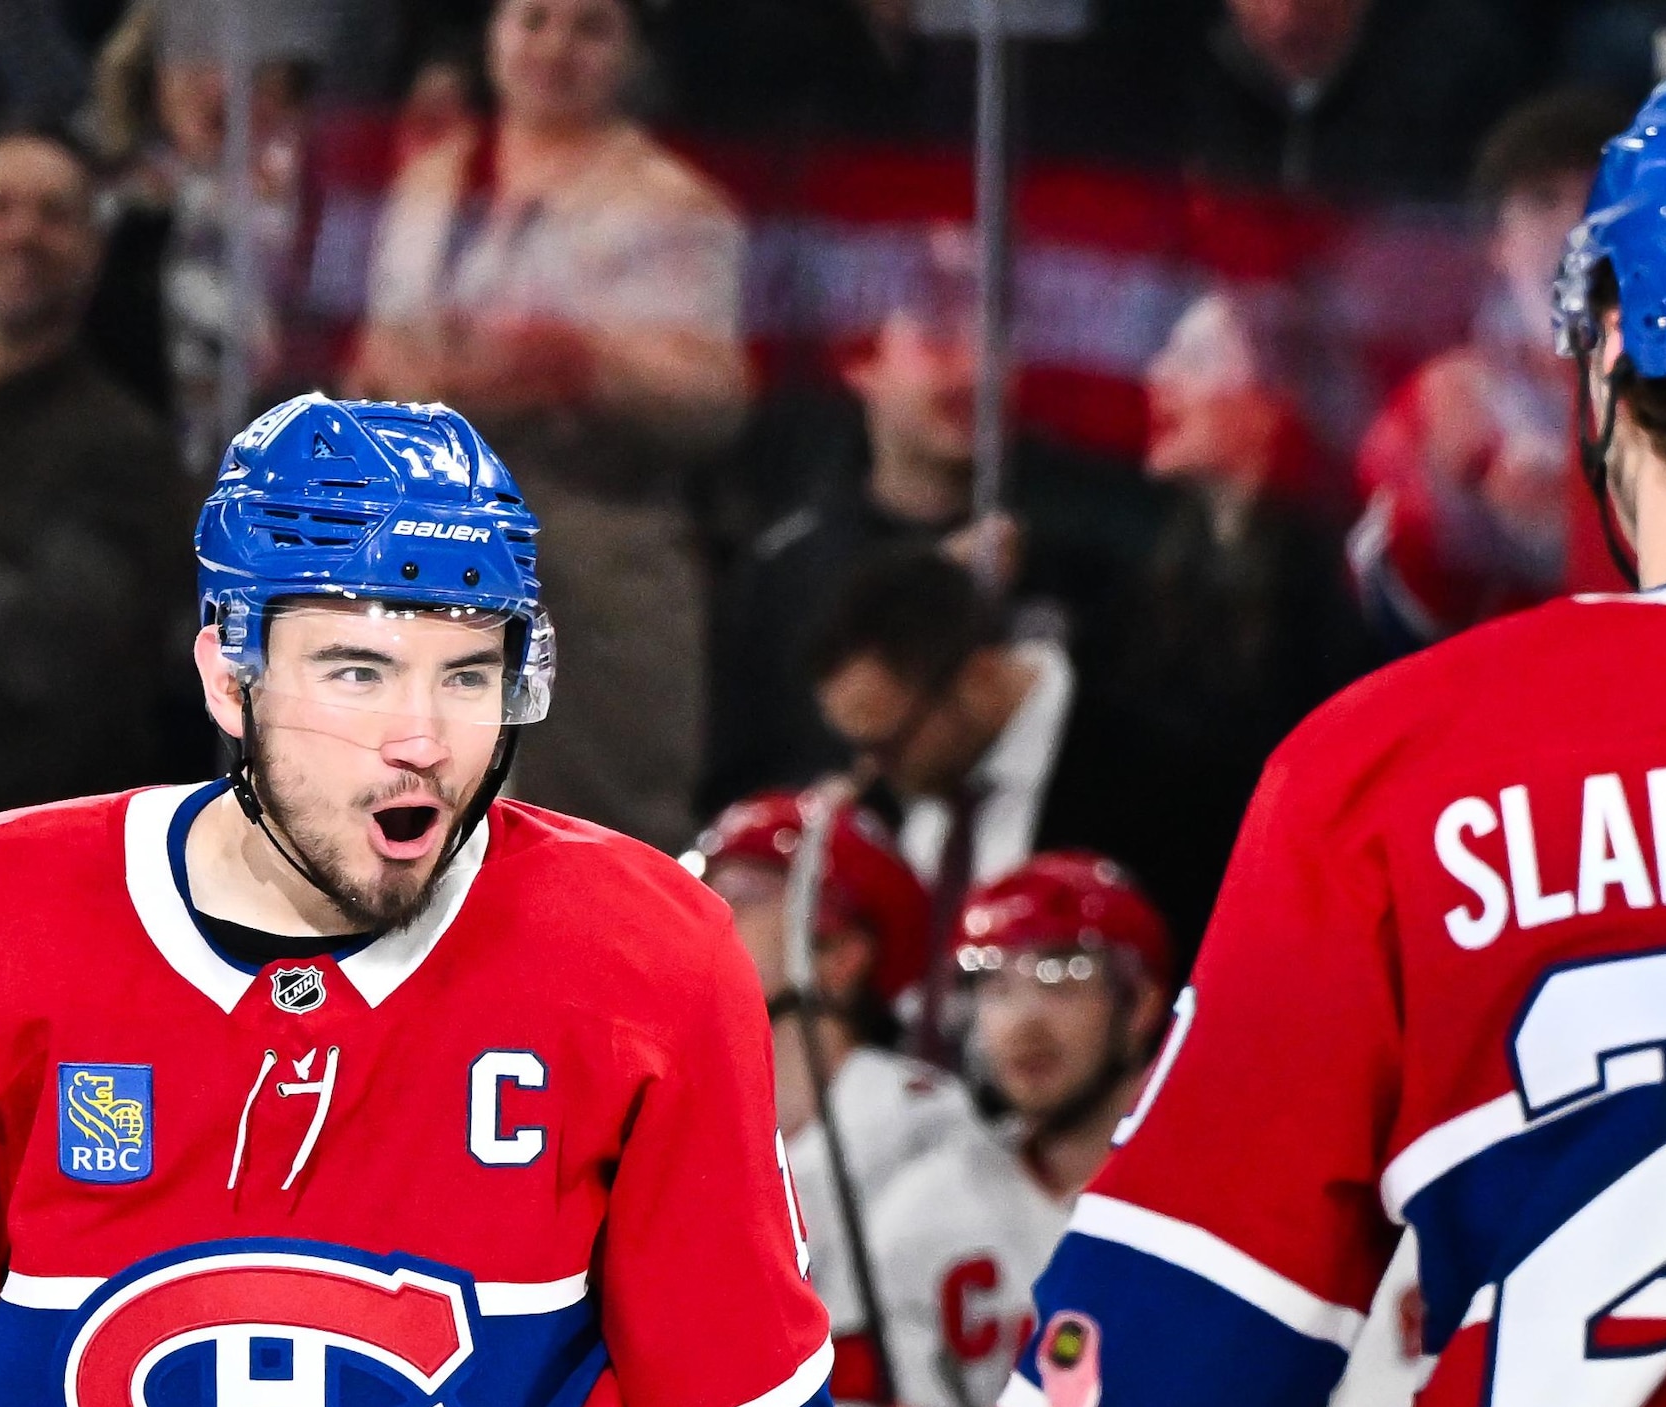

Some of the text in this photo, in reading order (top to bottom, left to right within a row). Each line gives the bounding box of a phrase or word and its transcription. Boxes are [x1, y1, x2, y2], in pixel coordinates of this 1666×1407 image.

[398, 445, 471, 487] 14
[283, 973, 315, 1004] LNH
[466, 1048, 548, 1168] C
[70, 1145, 141, 1172] RBC
